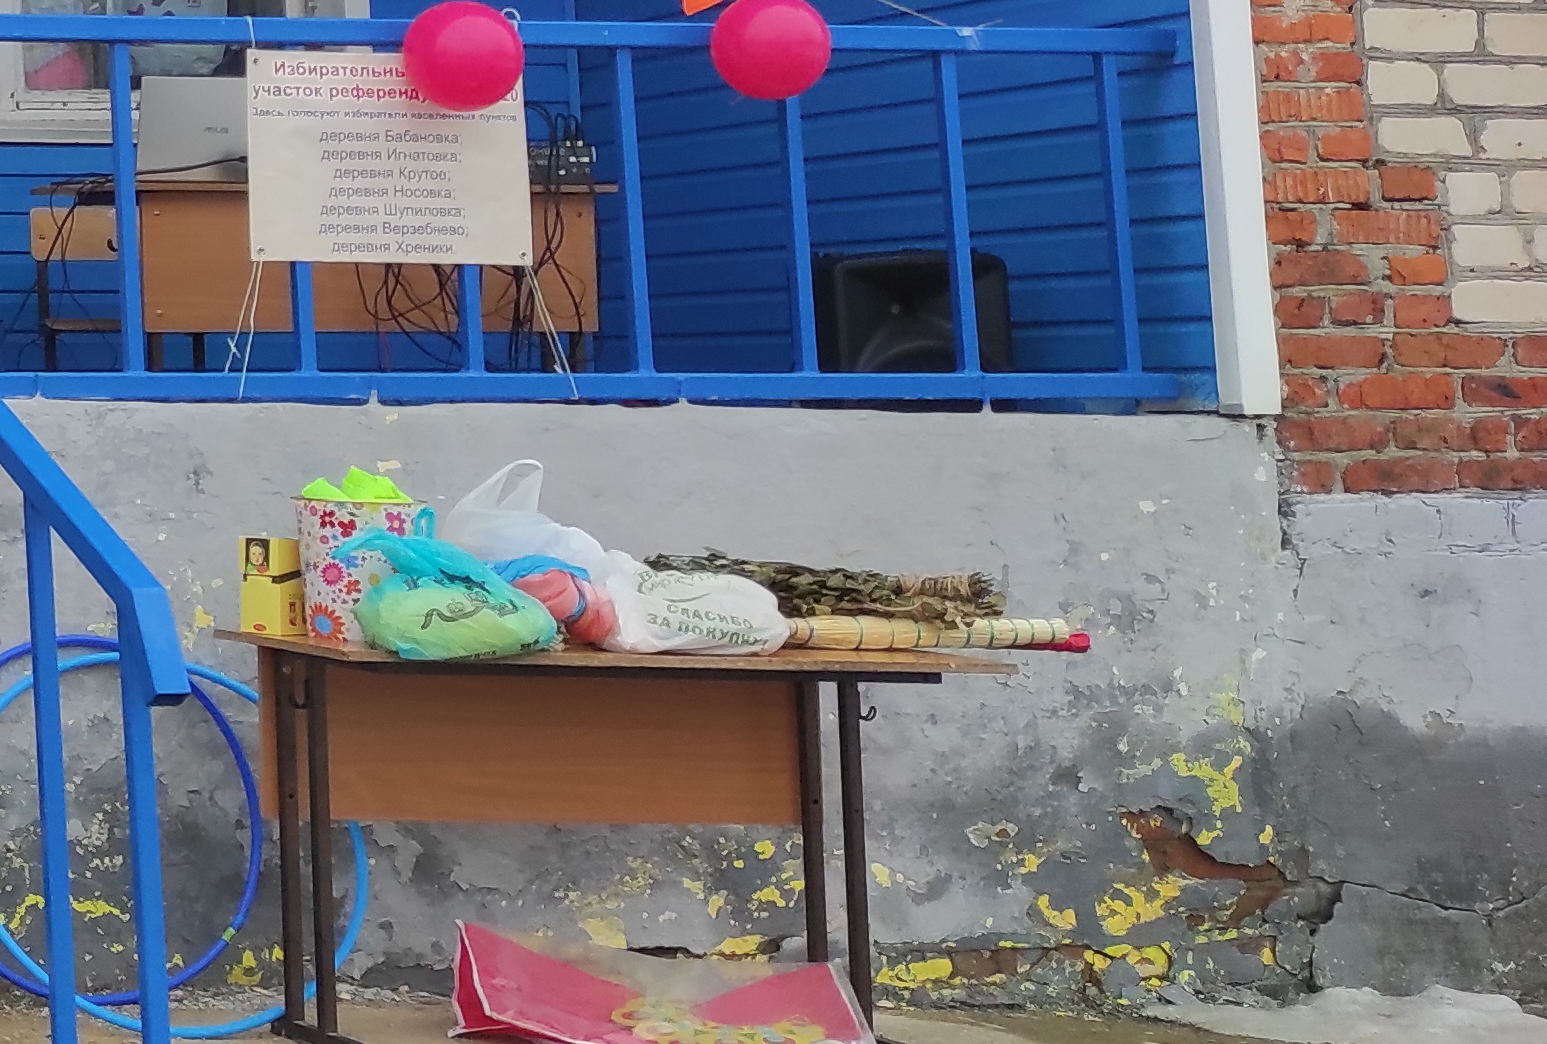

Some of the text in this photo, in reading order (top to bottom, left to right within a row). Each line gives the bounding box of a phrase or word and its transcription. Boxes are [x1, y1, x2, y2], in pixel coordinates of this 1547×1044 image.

[252, 84, 322, 99] участок
[319, 131, 380, 143] деревня
[321, 149, 382, 162] деревня
[333, 168, 393, 180] деревня
[329, 186, 389, 199] деревня
[320, 204, 379, 218] деревня
[319, 223, 377, 236] деревня
[332, 241, 391, 255] деревня
[647, 613, 670, 629] ЗА
[667, 604, 753, 629] СПАСИБО
